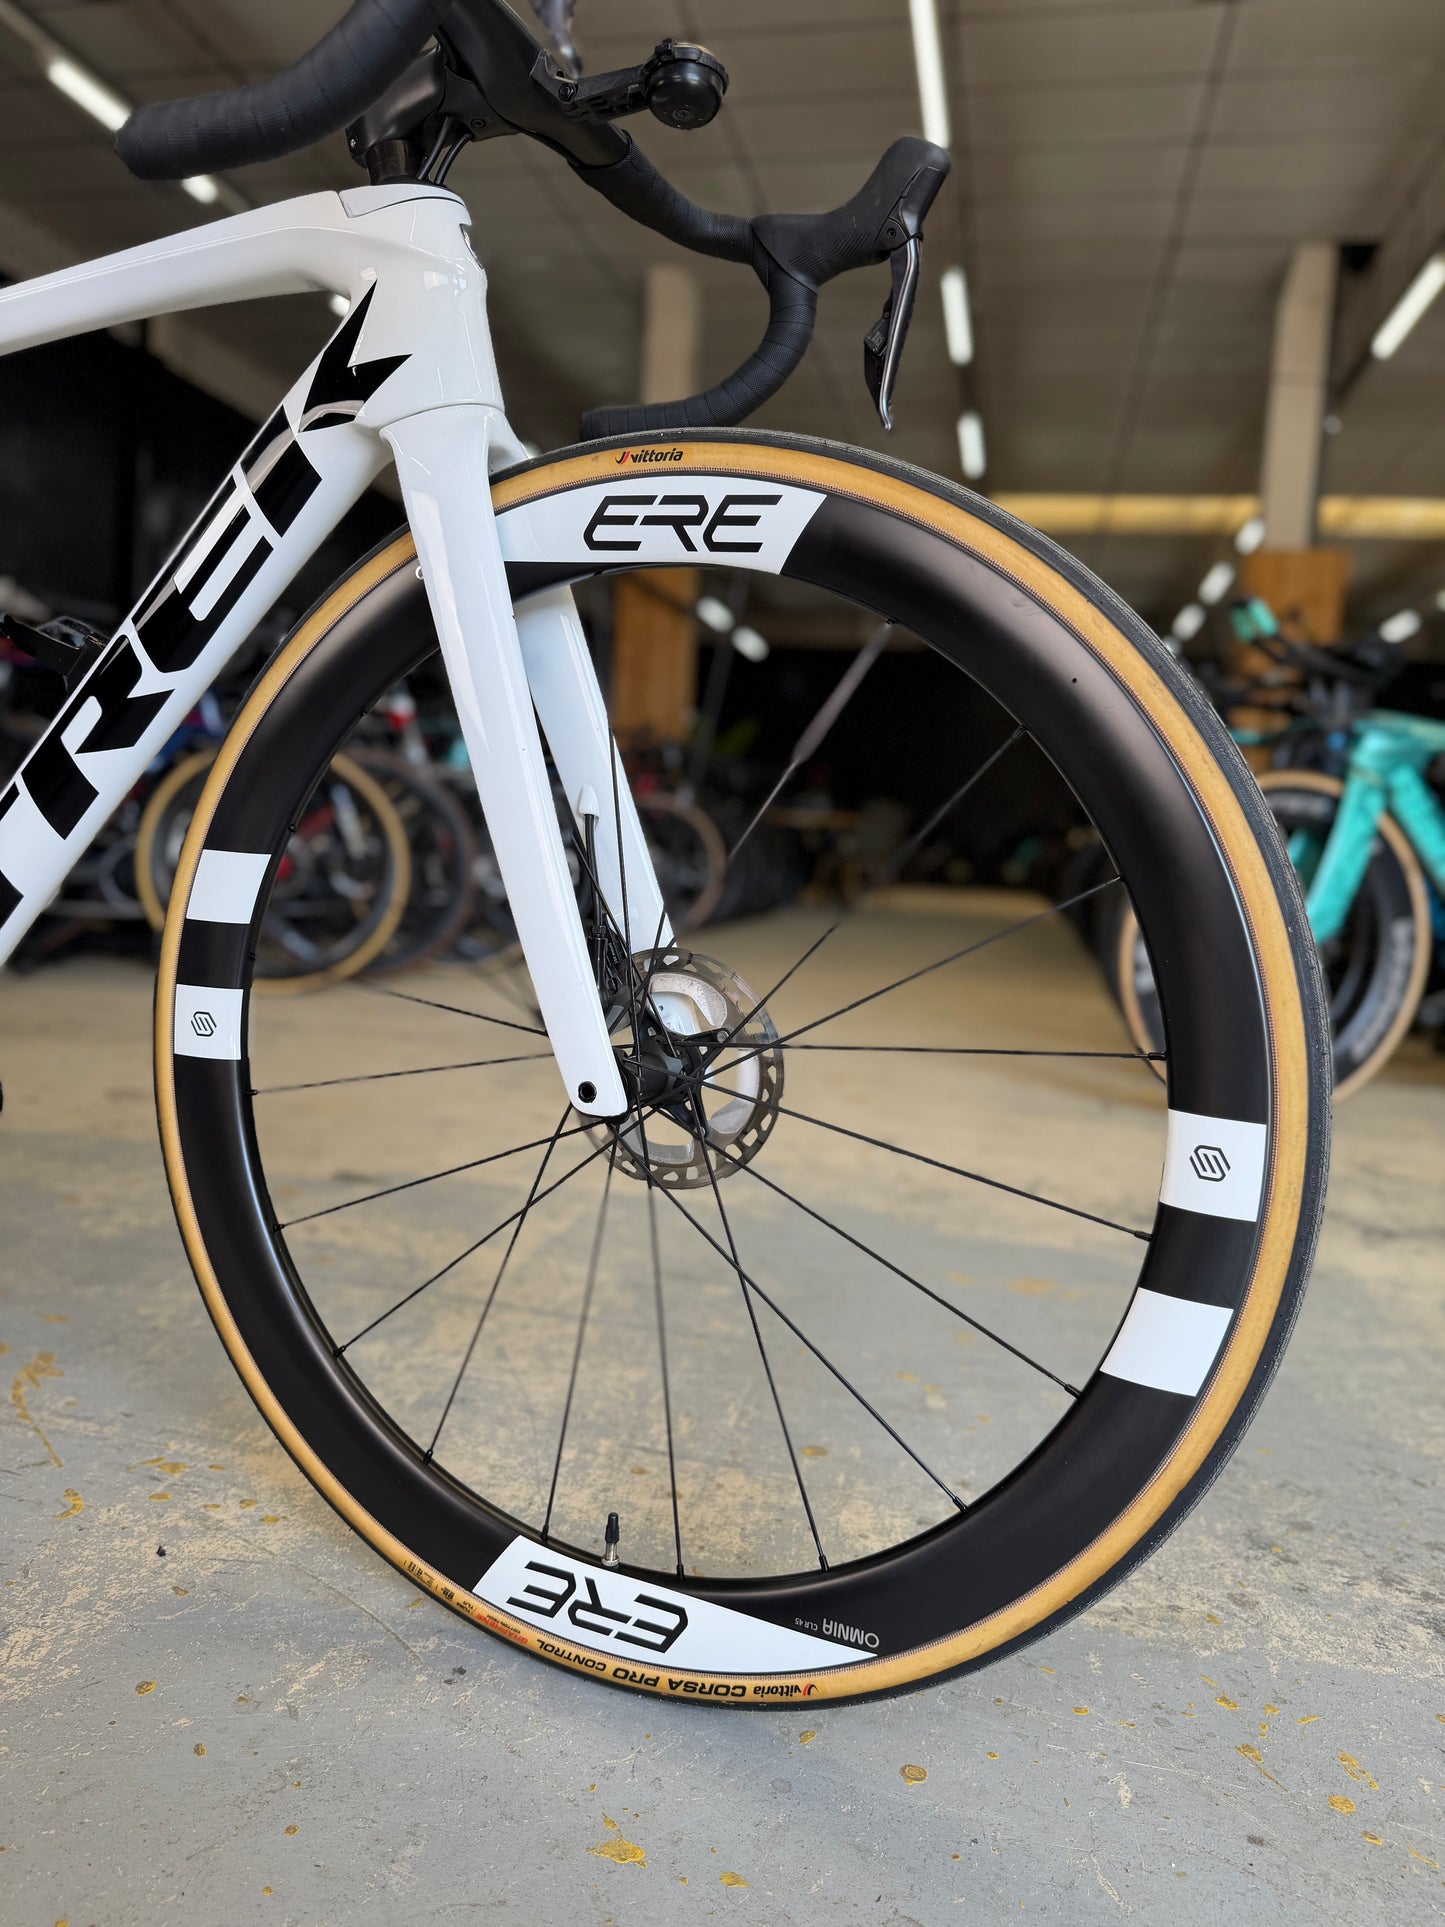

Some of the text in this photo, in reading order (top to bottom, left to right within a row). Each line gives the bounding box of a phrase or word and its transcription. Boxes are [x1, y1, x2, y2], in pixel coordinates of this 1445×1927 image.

[630, 447, 684, 463] vittoria
[583, 494, 783, 553] ERE
[476, 1613, 529, 1645] GRAPHENE
[506, 1560, 689, 1654] ERE
[794, 1617, 880, 1649] OMNIA CLR 45
[536, 1638, 803, 1697] vittoria CORSA PRO CONTROL
